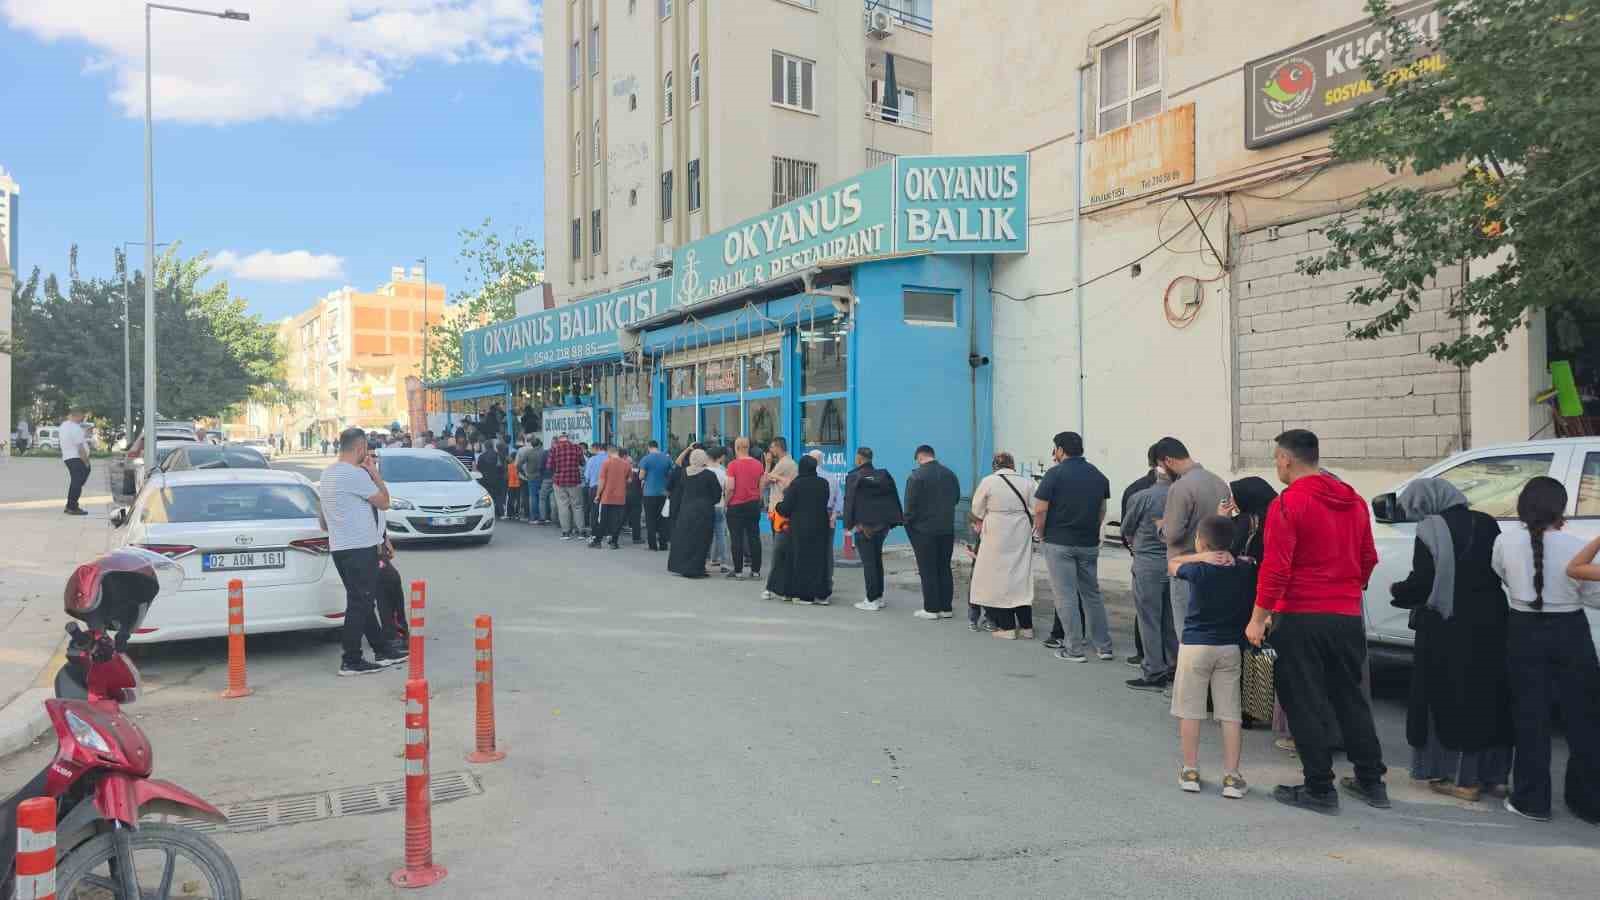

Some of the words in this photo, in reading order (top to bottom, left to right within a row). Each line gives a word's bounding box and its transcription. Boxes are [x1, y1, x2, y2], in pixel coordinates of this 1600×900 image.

[1324, 79, 1374, 107] SOSYAL
[905, 165, 1019, 201] OKYANUS
[723, 182, 864, 266] OKYANUS
[905, 207, 1020, 242] BALIK
[709, 269, 751, 297] BALIK
[768, 224, 885, 279] RESTAURANT
[483, 316, 554, 357] OKYANUS
[210, 554, 225, 568] 02
[262, 552, 282, 565] 161
